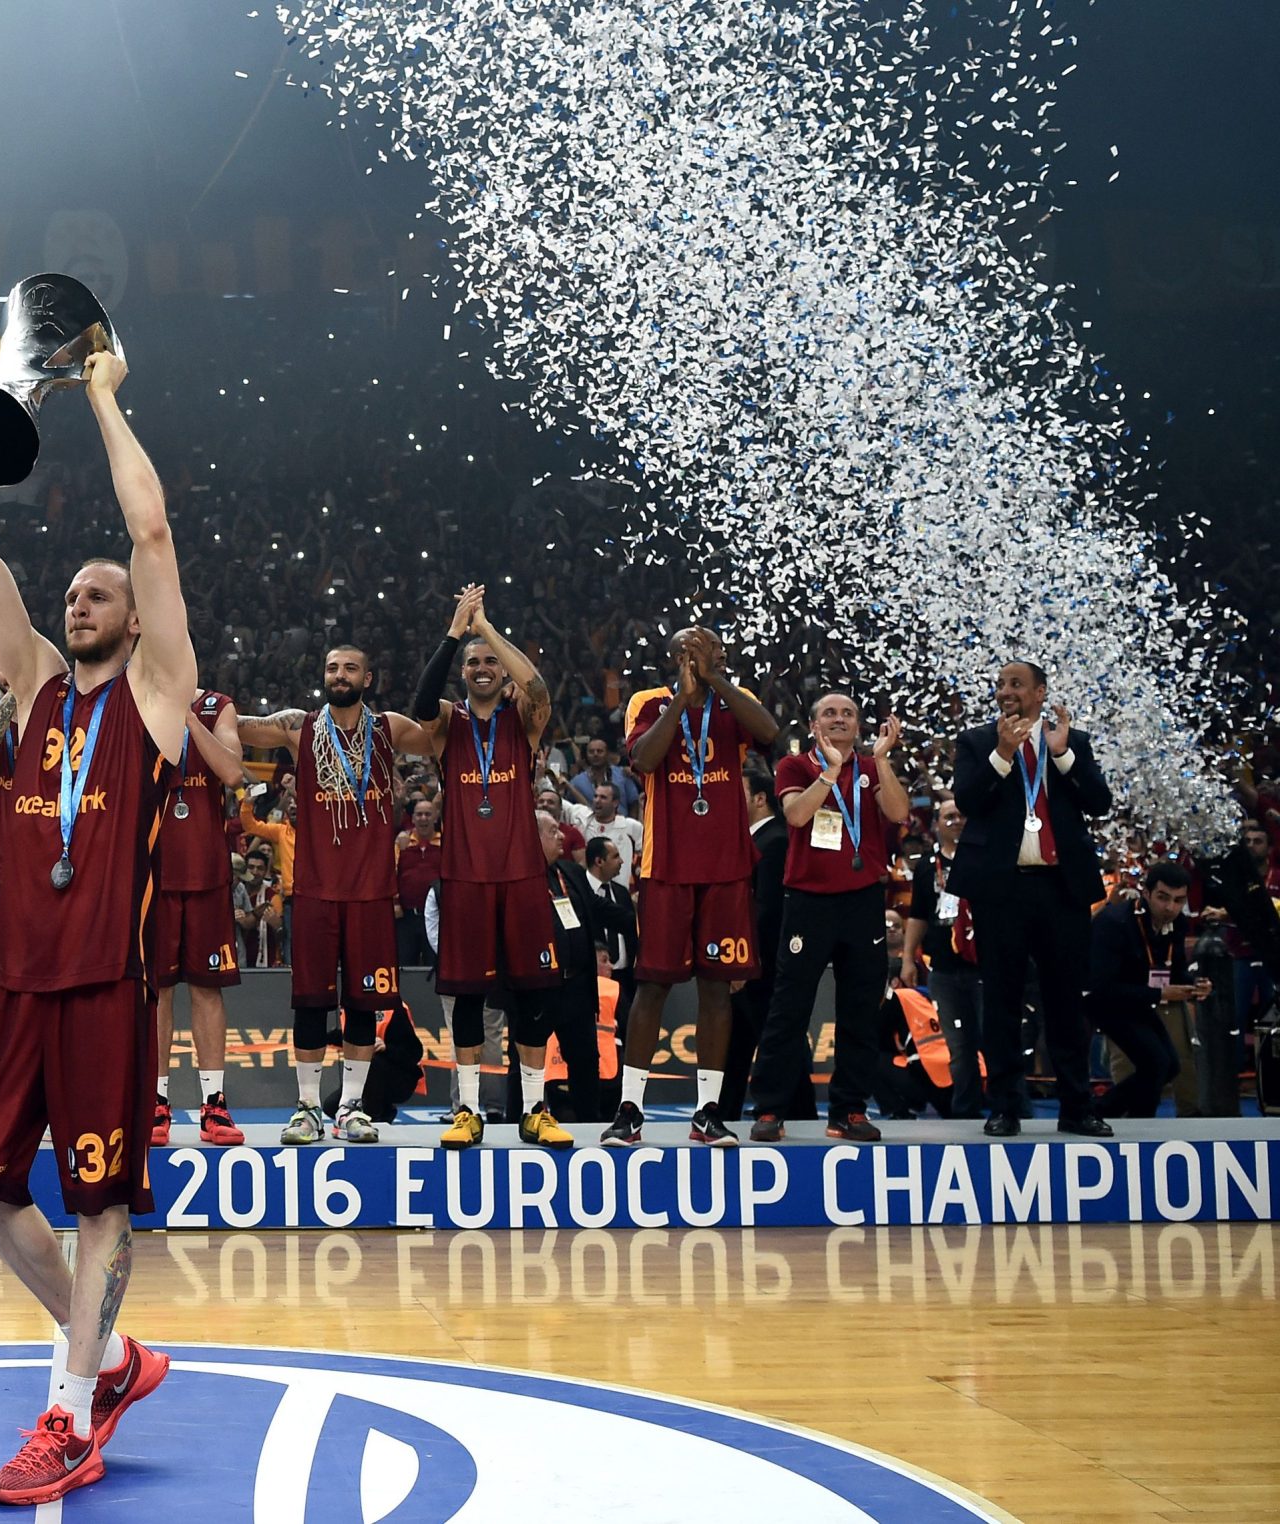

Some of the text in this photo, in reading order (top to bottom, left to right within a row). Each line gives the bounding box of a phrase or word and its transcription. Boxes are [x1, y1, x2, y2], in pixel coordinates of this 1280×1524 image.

[43, 728, 86, 770] 32
[720, 937, 749, 964] 30
[375, 967, 398, 994] 61
[76, 1128, 123, 1183] 32
[166, 1140, 1271, 1228] 2016 EUROCUP CHAMPION
